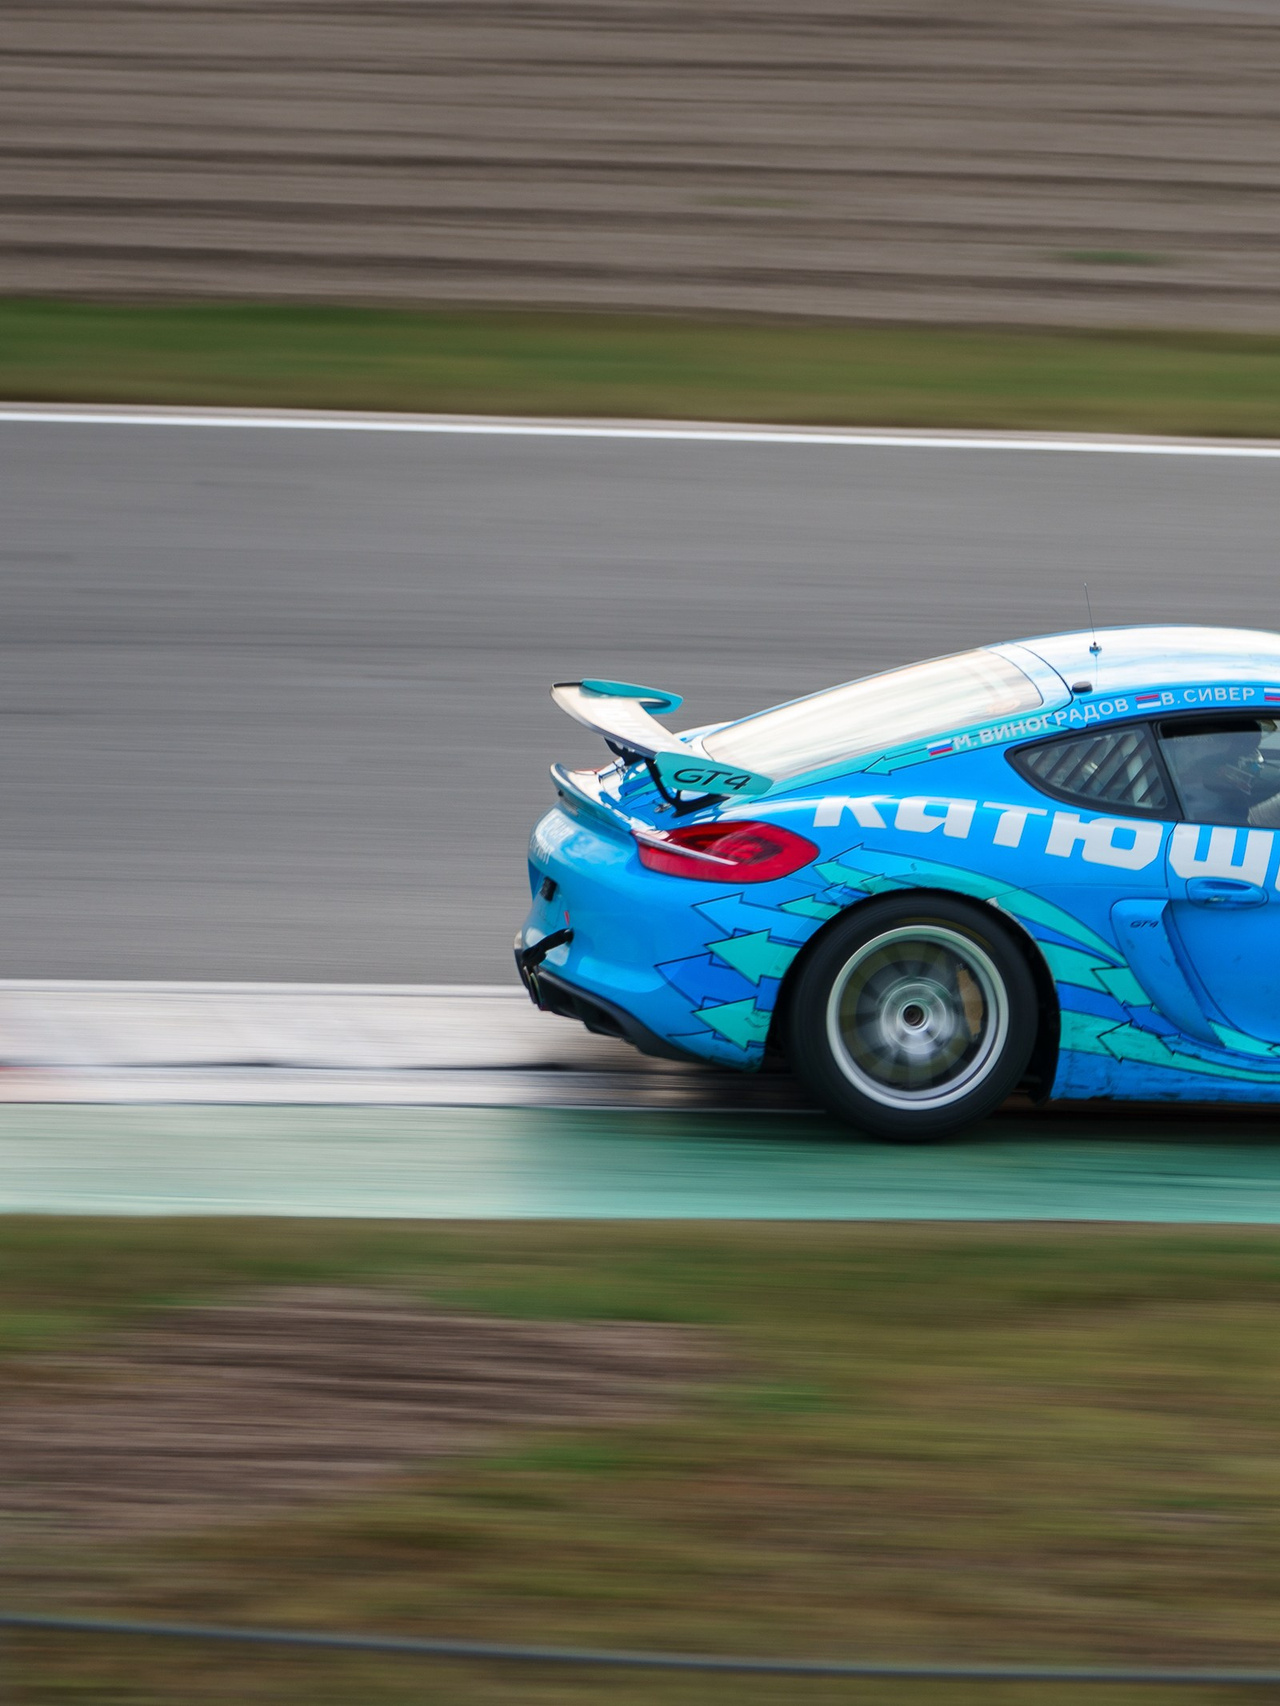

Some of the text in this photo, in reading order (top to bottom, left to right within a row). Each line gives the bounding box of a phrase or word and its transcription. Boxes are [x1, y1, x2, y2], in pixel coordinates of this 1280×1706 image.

[1184, 687, 1255, 703] СИВЕР
[980, 698, 1130, 744] ВИНОГРАДОВ
[673, 768, 752, 791] GT4
[1129, 920, 1160, 929] GT4
